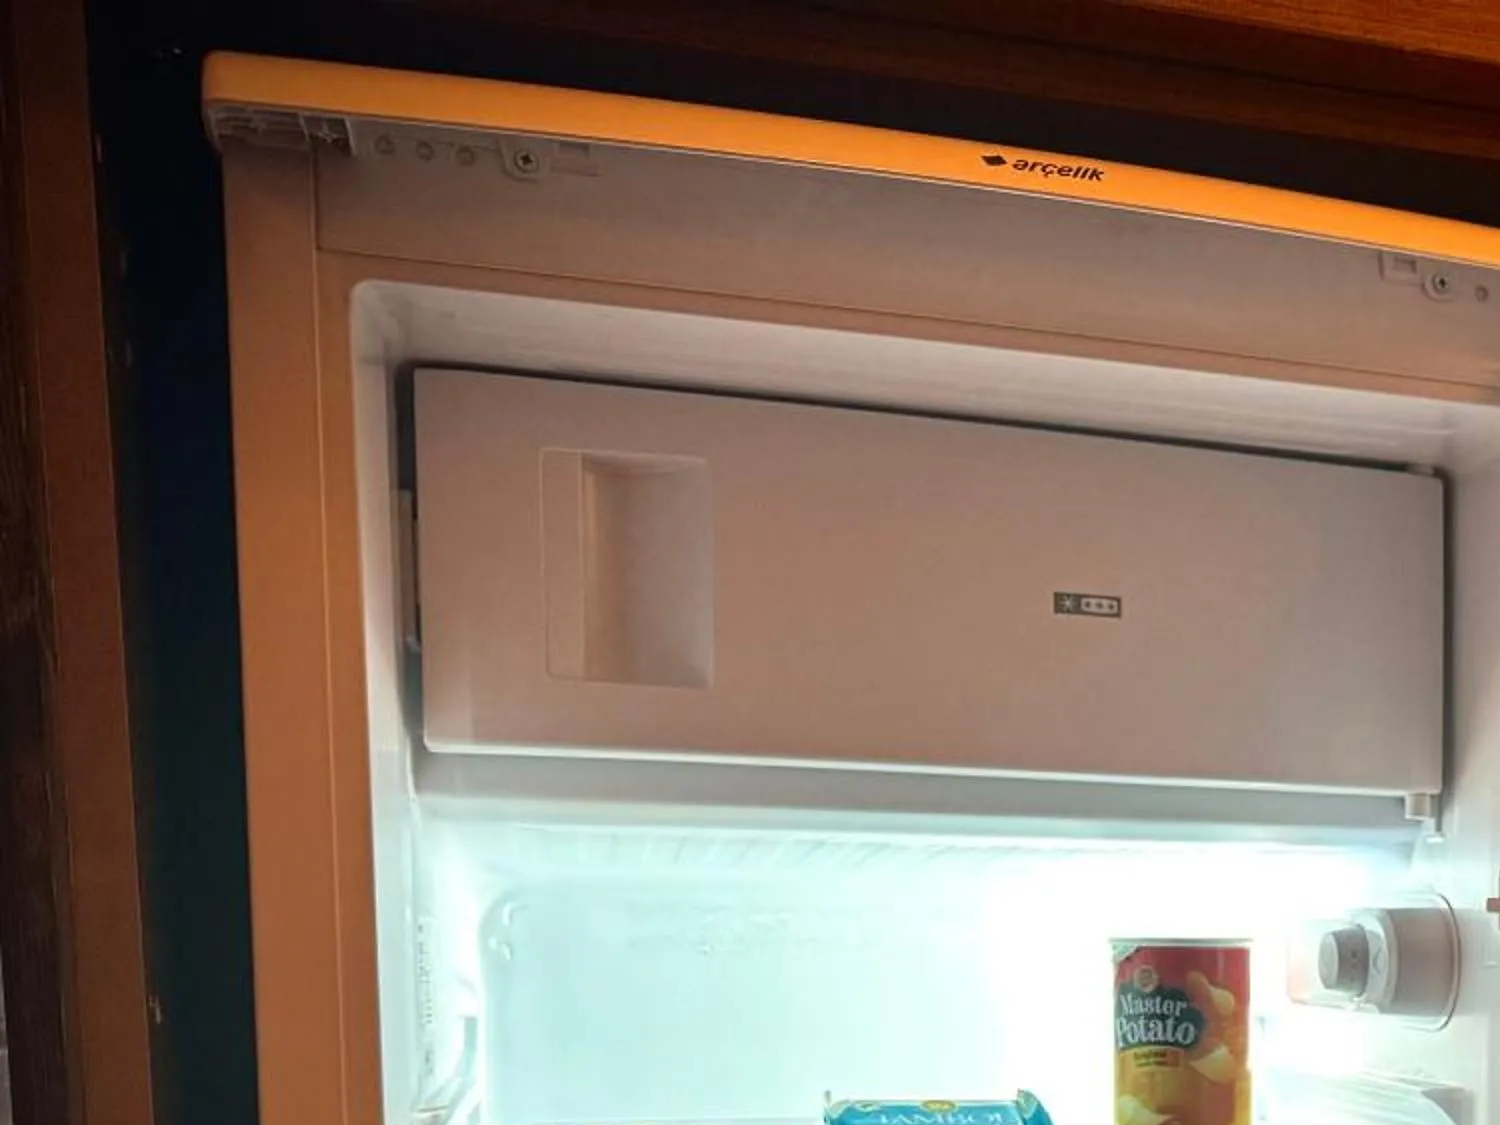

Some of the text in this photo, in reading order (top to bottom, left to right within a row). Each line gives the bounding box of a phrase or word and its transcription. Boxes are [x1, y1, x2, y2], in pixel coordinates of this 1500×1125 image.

[1012, 159, 1105, 182] arçelik
[1119, 992, 1188, 1016] Master
[1115, 1013, 1196, 1049] Potato
